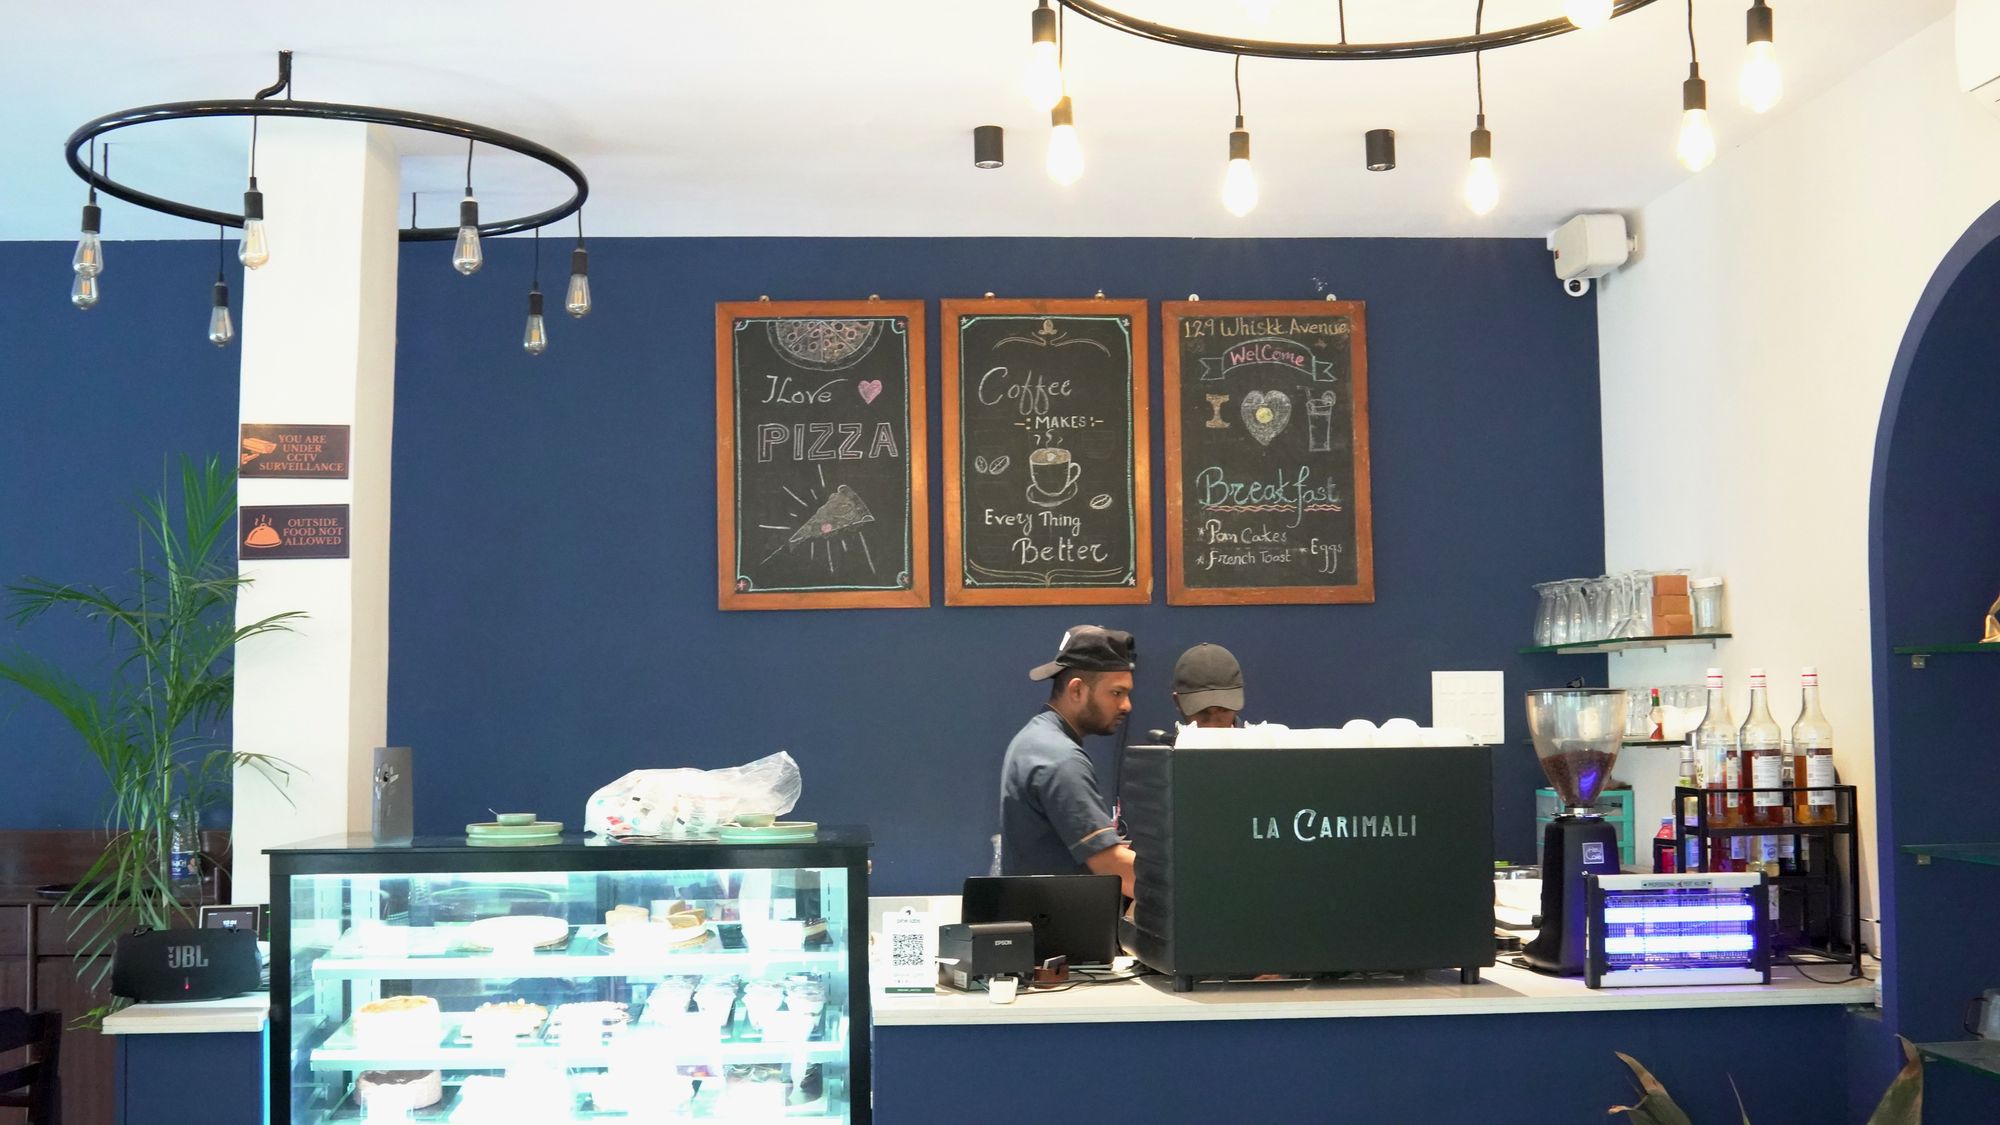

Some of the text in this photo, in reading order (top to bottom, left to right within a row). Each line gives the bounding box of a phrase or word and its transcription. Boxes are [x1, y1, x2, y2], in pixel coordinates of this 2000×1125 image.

[1184, 318, 1214, 338] 129
[978, 366, 1072, 416] Coffee
[1034, 416, 1087, 430] MAKES
[278, 434, 327, 444] YOU ARE
[283, 444, 322, 453] UNDER
[757, 422, 899, 463] PIZZA
[259, 462, 345, 472] SURVEILLANCE
[286, 453, 318, 462] CCTV
[1196, 465, 1341, 528] Breakfast
[283, 527, 344, 537] FOOD NOT
[287, 518, 338, 528] OUTSIDE
[1038, 511, 1082, 535] Thing
[1240, 523, 1288, 545] Cakes
[284, 536, 342, 546] ALLOWED
[1012, 537, 1108, 564] Better
[1205, 549, 1293, 571] French Toast
[1310, 538, 1343, 574] Eggs
[1252, 817, 1280, 839] LA
[168, 945, 209, 968] JBL
